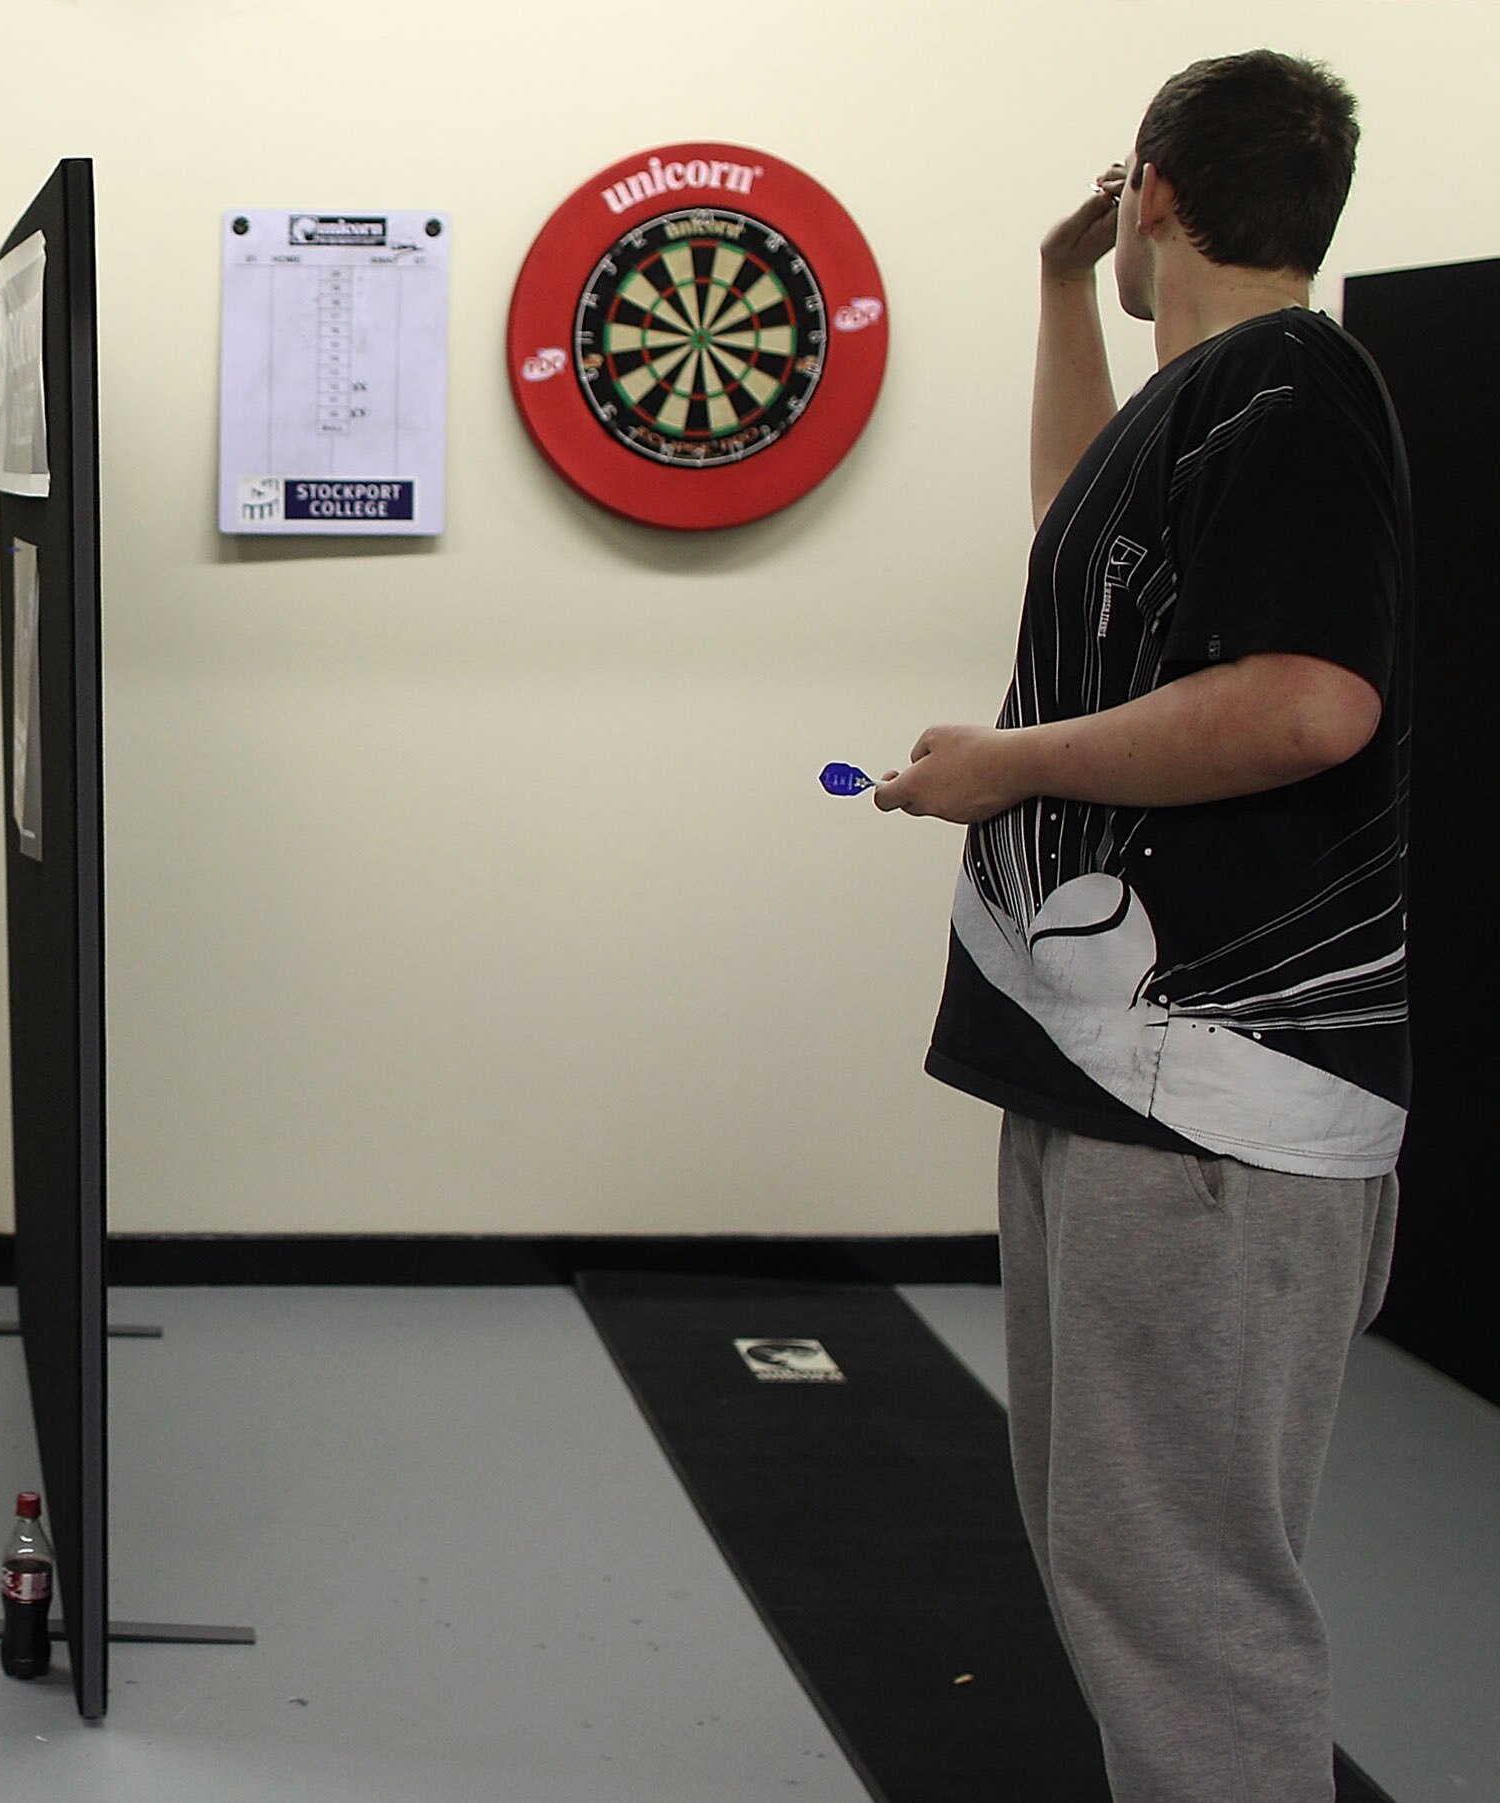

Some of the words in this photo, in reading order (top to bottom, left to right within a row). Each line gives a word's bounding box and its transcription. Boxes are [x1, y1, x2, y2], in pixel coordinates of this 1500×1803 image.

[601, 156, 754, 214] unicorn
[296, 483, 402, 500] STOCKPORT
[309, 501, 389, 517] COLLEGE
